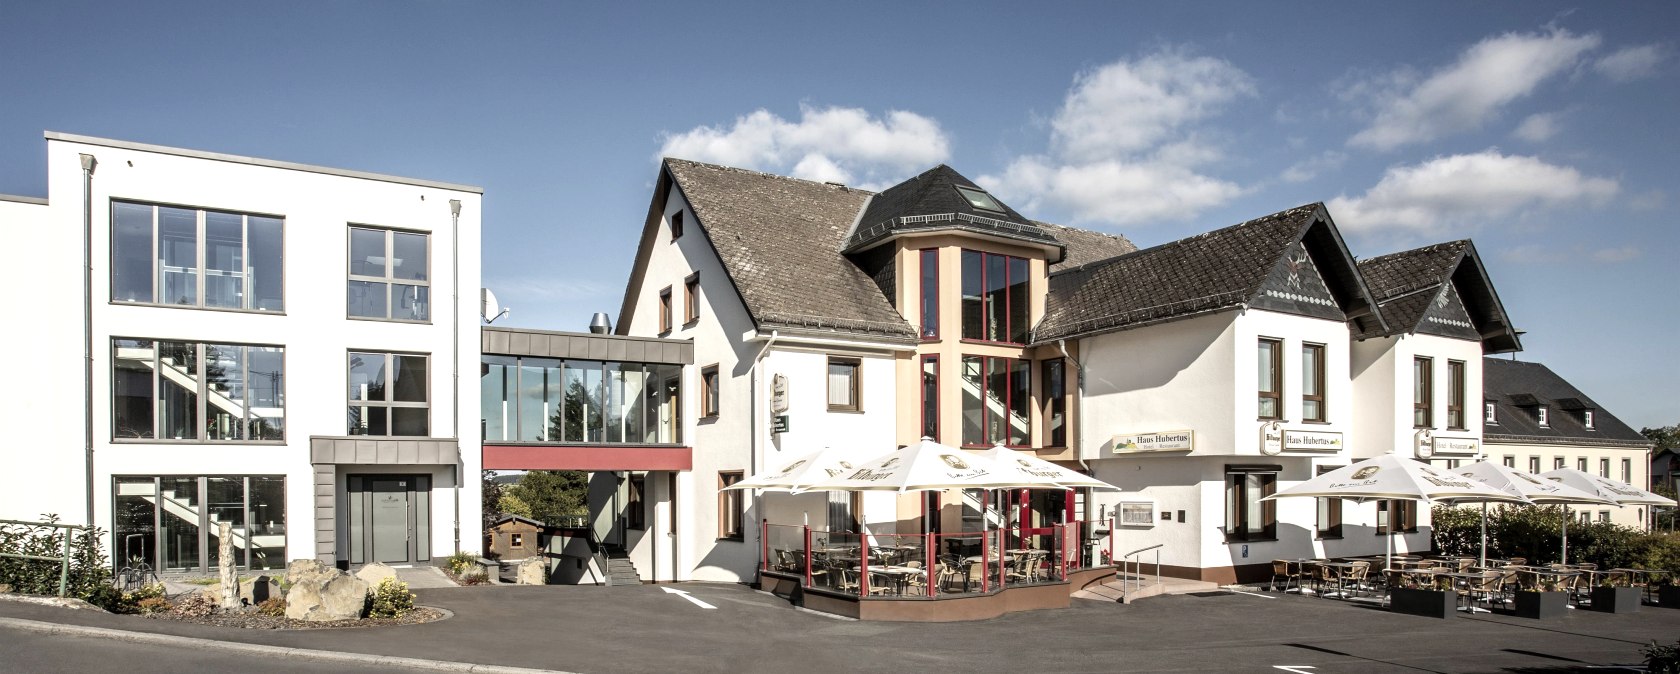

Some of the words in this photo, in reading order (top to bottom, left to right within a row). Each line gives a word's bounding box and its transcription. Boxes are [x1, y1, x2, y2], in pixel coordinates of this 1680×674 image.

[1137, 436, 1154, 444] Haus
[1155, 434, 1188, 443] Hubertus
[1286, 435, 1302, 444] Haus
[1303, 436, 1330, 445] Hubertus
